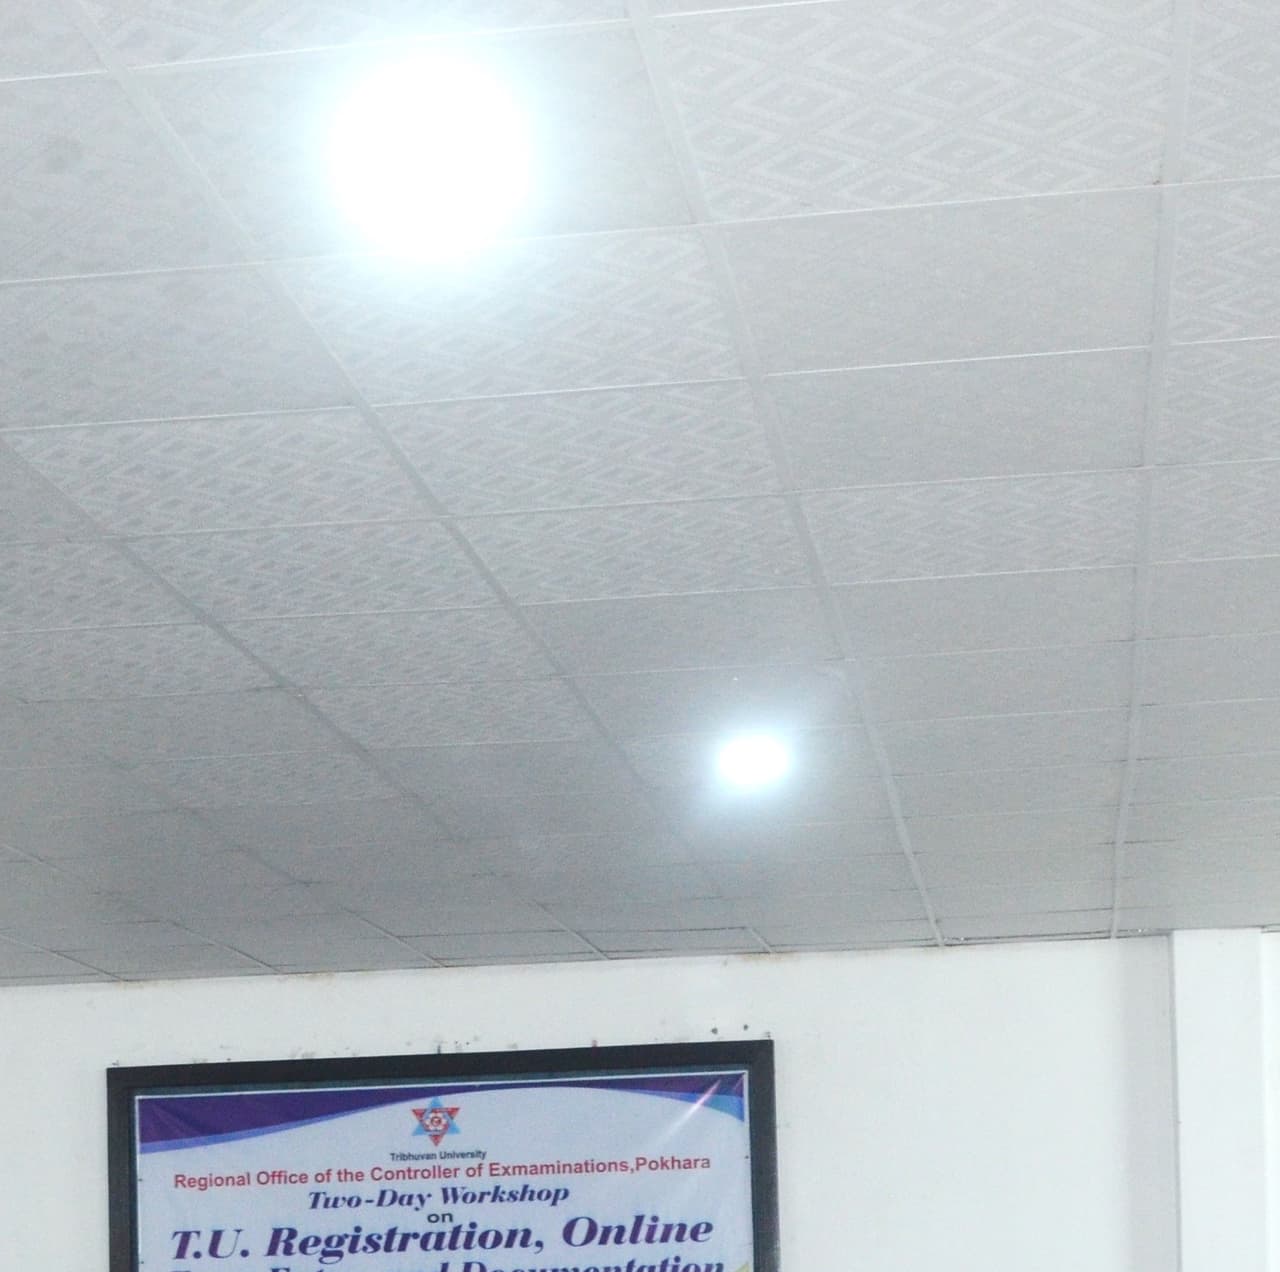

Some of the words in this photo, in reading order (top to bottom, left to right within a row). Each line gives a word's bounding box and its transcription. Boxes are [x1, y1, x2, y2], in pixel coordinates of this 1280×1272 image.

[390, 1151, 437, 1162] Tribhuvan
[439, 1149, 487, 1161] University
[174, 1171, 250, 1191] Regional
[256, 1169, 308, 1185] Office
[314, 1168, 332, 1183] of
[337, 1167, 365, 1182] the
[370, 1164, 459, 1181] Controller
[466, 1162, 483, 1178] of
[309, 1188, 433, 1212] Two-Day
[441, 1184, 570, 1206] Workshop
[426, 1213, 454, 1224] on
[171, 1229, 250, 1260] T.U.
[264, 1221, 544, 1265] Registration,
[562, 1214, 713, 1247] Online
